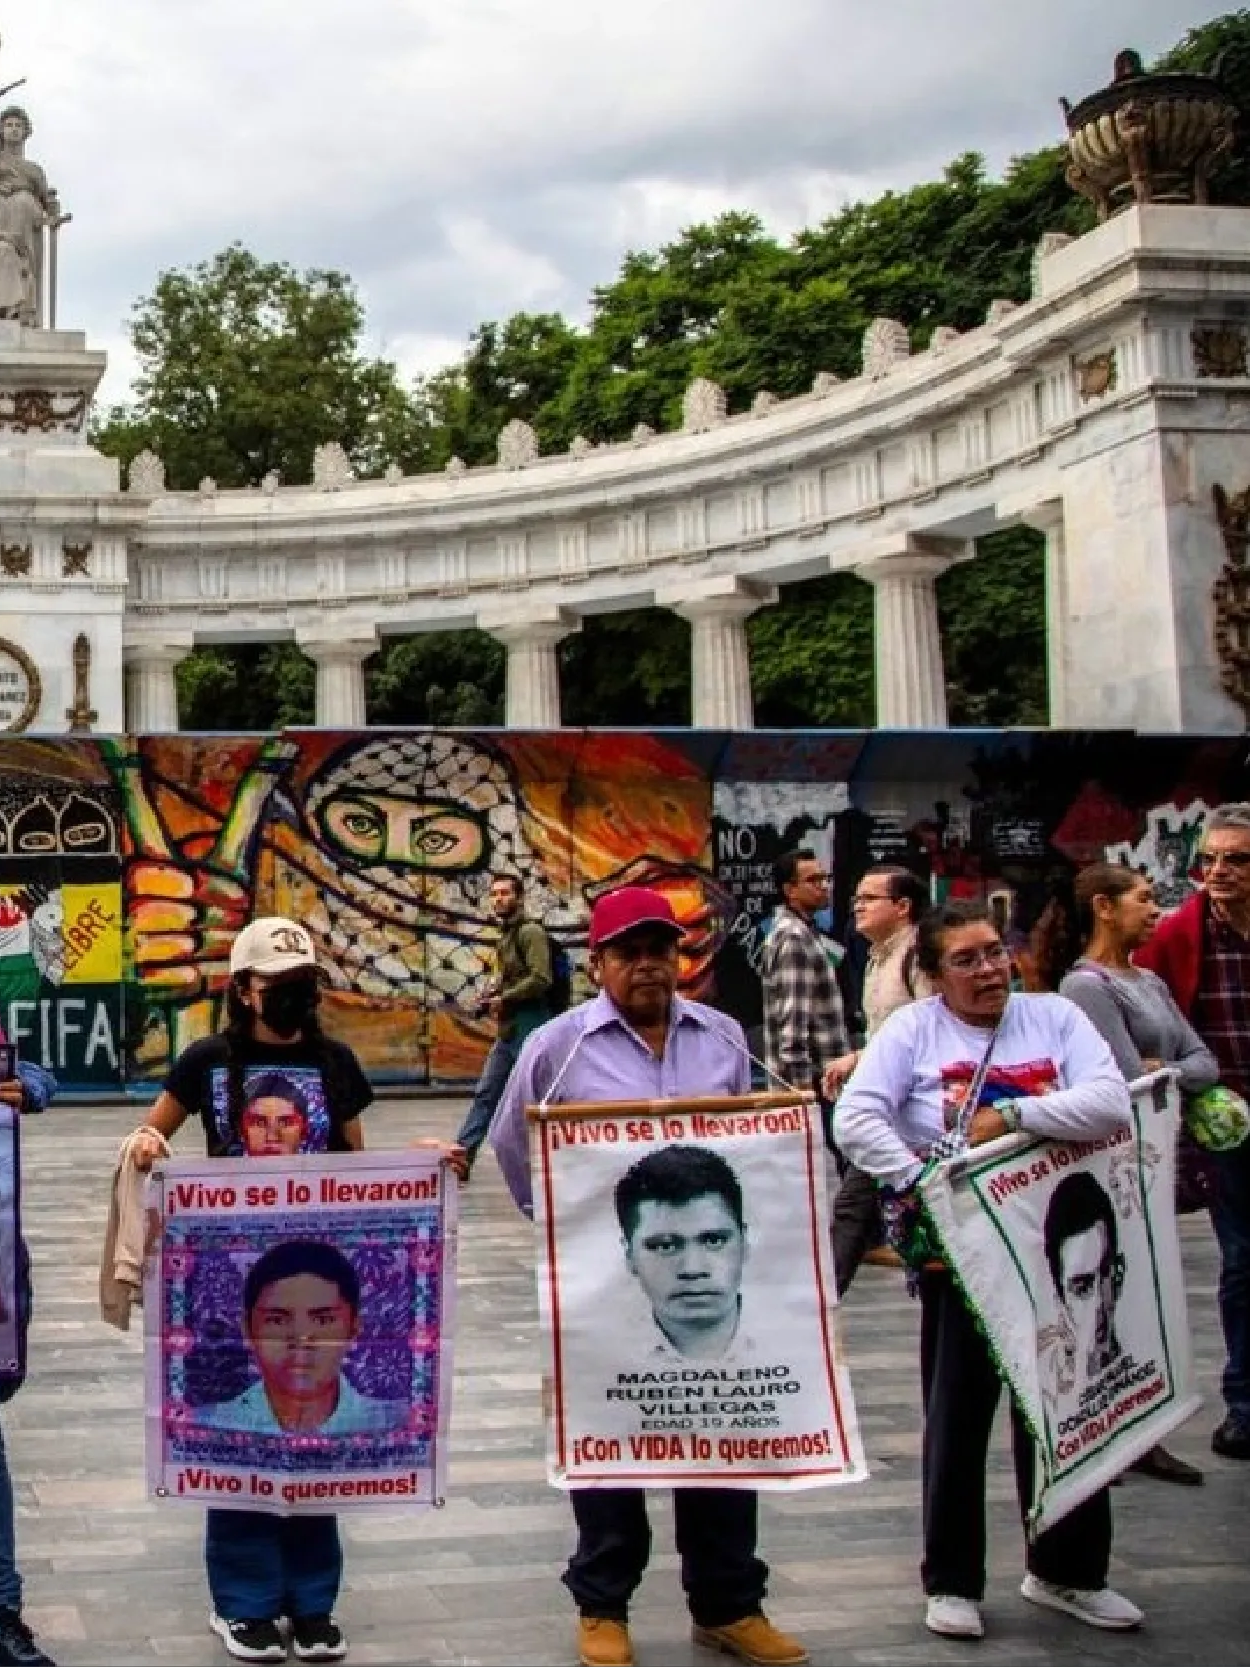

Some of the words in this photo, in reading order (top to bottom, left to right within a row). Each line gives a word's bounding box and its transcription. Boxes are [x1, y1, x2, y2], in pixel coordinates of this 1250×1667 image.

[718, 827, 757, 860] NO
[61, 897, 116, 971] LIBRE
[8, 999, 119, 1069] FIFA
[552, 1119, 619, 1150] ¡Vivo
[625, 1120, 654, 1141] se
[661, 1115, 684, 1140] lo
[692, 1109, 802, 1138] llevaron!
[167, 1176, 237, 1214] ¡Vivo
[245, 1185, 278, 1205] se
[286, 1179, 311, 1205] lo
[319, 1173, 439, 1204] llevaron!
[616, 1365, 790, 1384] MAGDALENO
[713, 1381, 800, 1398] LAURO
[639, 1400, 776, 1416] VILLEGAS
[641, 1419, 694, 1430] EDAD
[730, 1415, 782, 1428] AÑOS
[573, 1434, 622, 1465] ¡Con
[629, 1433, 684, 1461] VIDA
[690, 1433, 712, 1461] lo
[718, 1429, 833, 1465] queremos!
[177, 1468, 242, 1495] ¡Vivo
[251, 1474, 274, 1496] lo
[281, 1471, 418, 1502] queremos!
